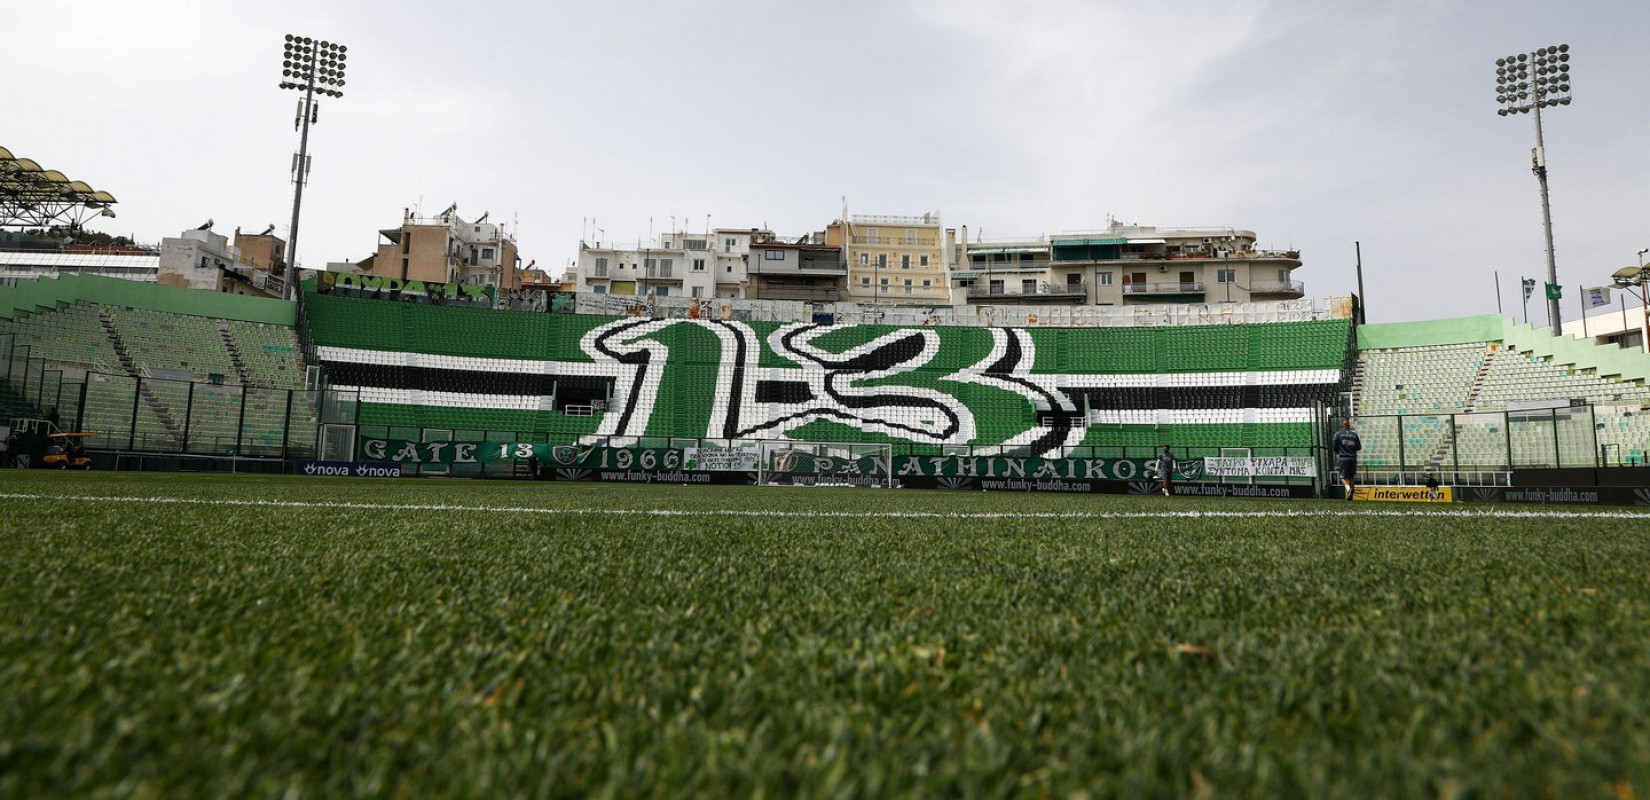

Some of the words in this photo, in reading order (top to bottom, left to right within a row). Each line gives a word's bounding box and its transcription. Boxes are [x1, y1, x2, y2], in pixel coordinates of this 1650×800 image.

[364, 439, 477, 463] GATE
[500, 442, 535, 458] 13
[601, 447, 679, 470] 1966
[317, 464, 349, 476] nova
[368, 466, 400, 477] nova
[601, 470, 710, 483] www.funky-buddha.com
[1289, 467, 1307, 475] ΜΑΣ
[981, 479, 1091, 492] www.funky-buddha.com
[1174, 484, 1290, 497] www.funky-buddha.com
[1505, 487, 1598, 502] www.funky-buddha.com
